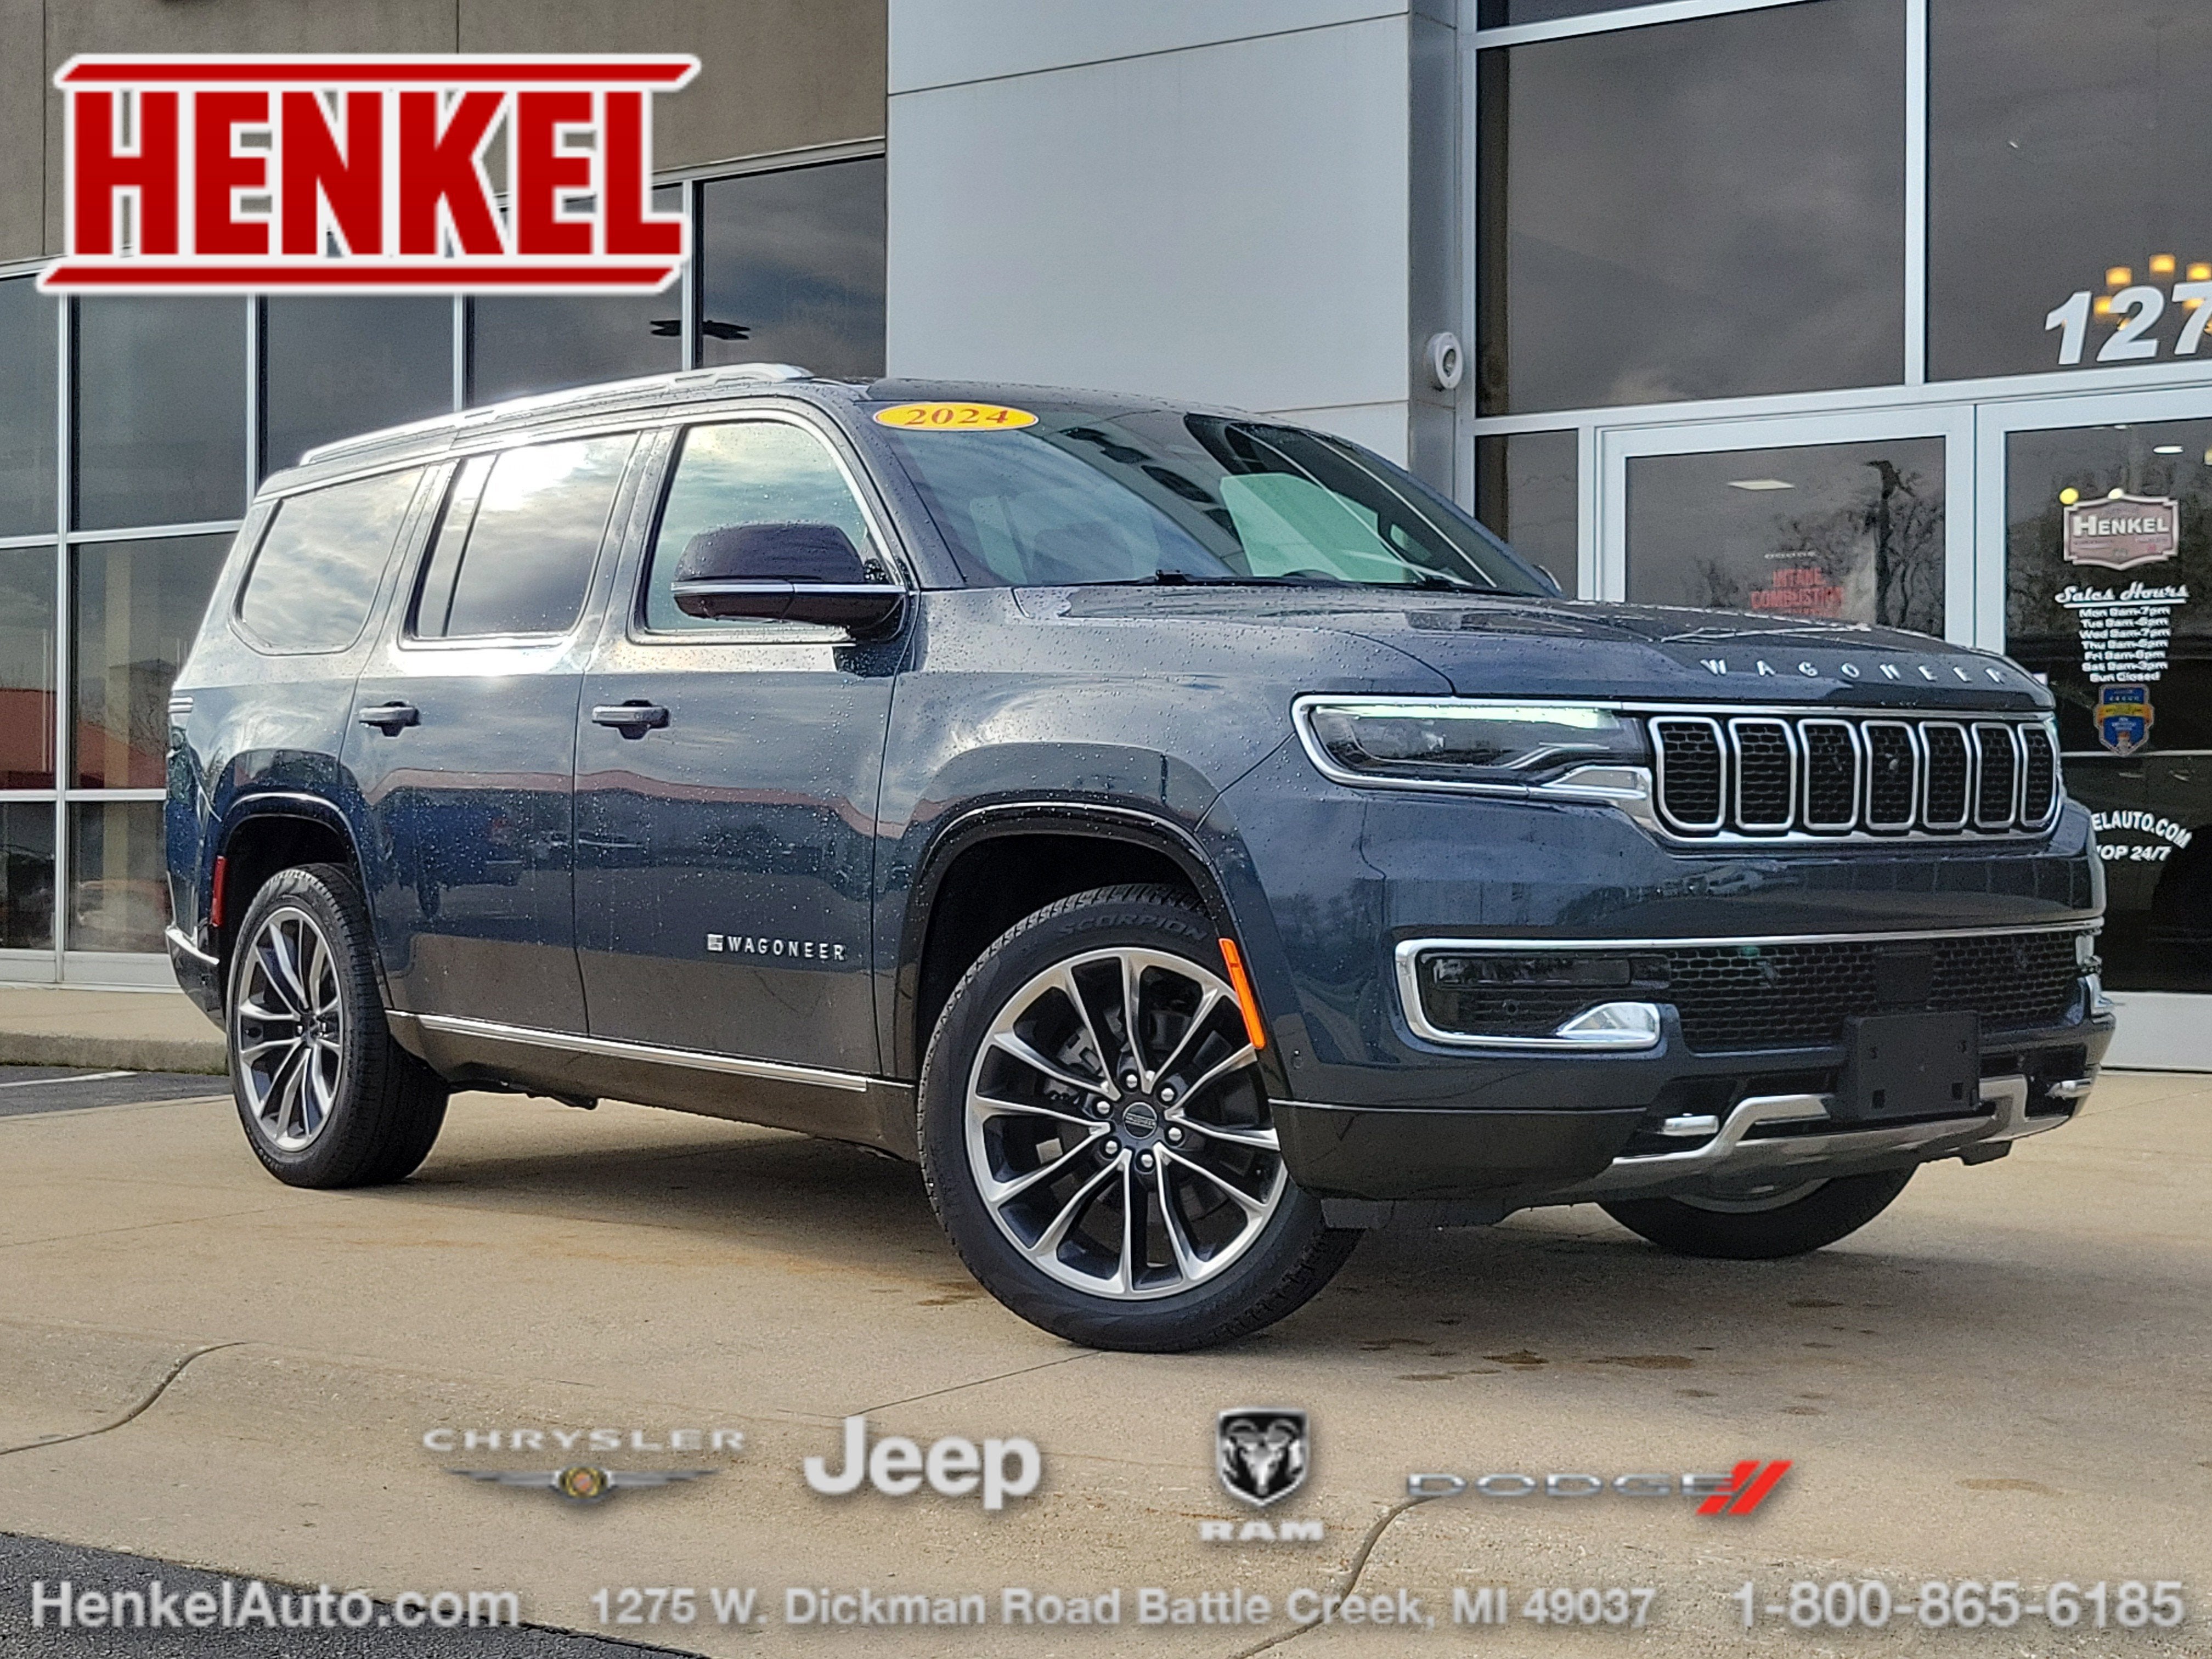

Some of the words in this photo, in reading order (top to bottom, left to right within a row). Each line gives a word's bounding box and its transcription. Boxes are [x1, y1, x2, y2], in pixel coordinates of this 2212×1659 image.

[905, 408, 1009, 425] 2024
[2073, 515, 2169, 537] HENKEL
[2055, 585, 2115, 603] Sales
[2120, 581, 2190, 601] Hours
[2079, 608, 2108, 618] Mon
[2080, 618, 2104, 628] Tue
[2079, 629, 2108, 639] Wed
[2081, 640, 2106, 650] Thu
[2084, 651, 2103, 661] Fri
[1700, 659, 2007, 684] WAGONEER
[2089, 673, 2115, 682] Sun
[2116, 671, 2161, 682] Closed
[2091, 810, 2193, 849] ELAUTO.COM
[2096, 844, 2129, 860] OP
[2129, 845, 2172, 861] 24/7
[727, 935, 845, 961] WAGONEER
